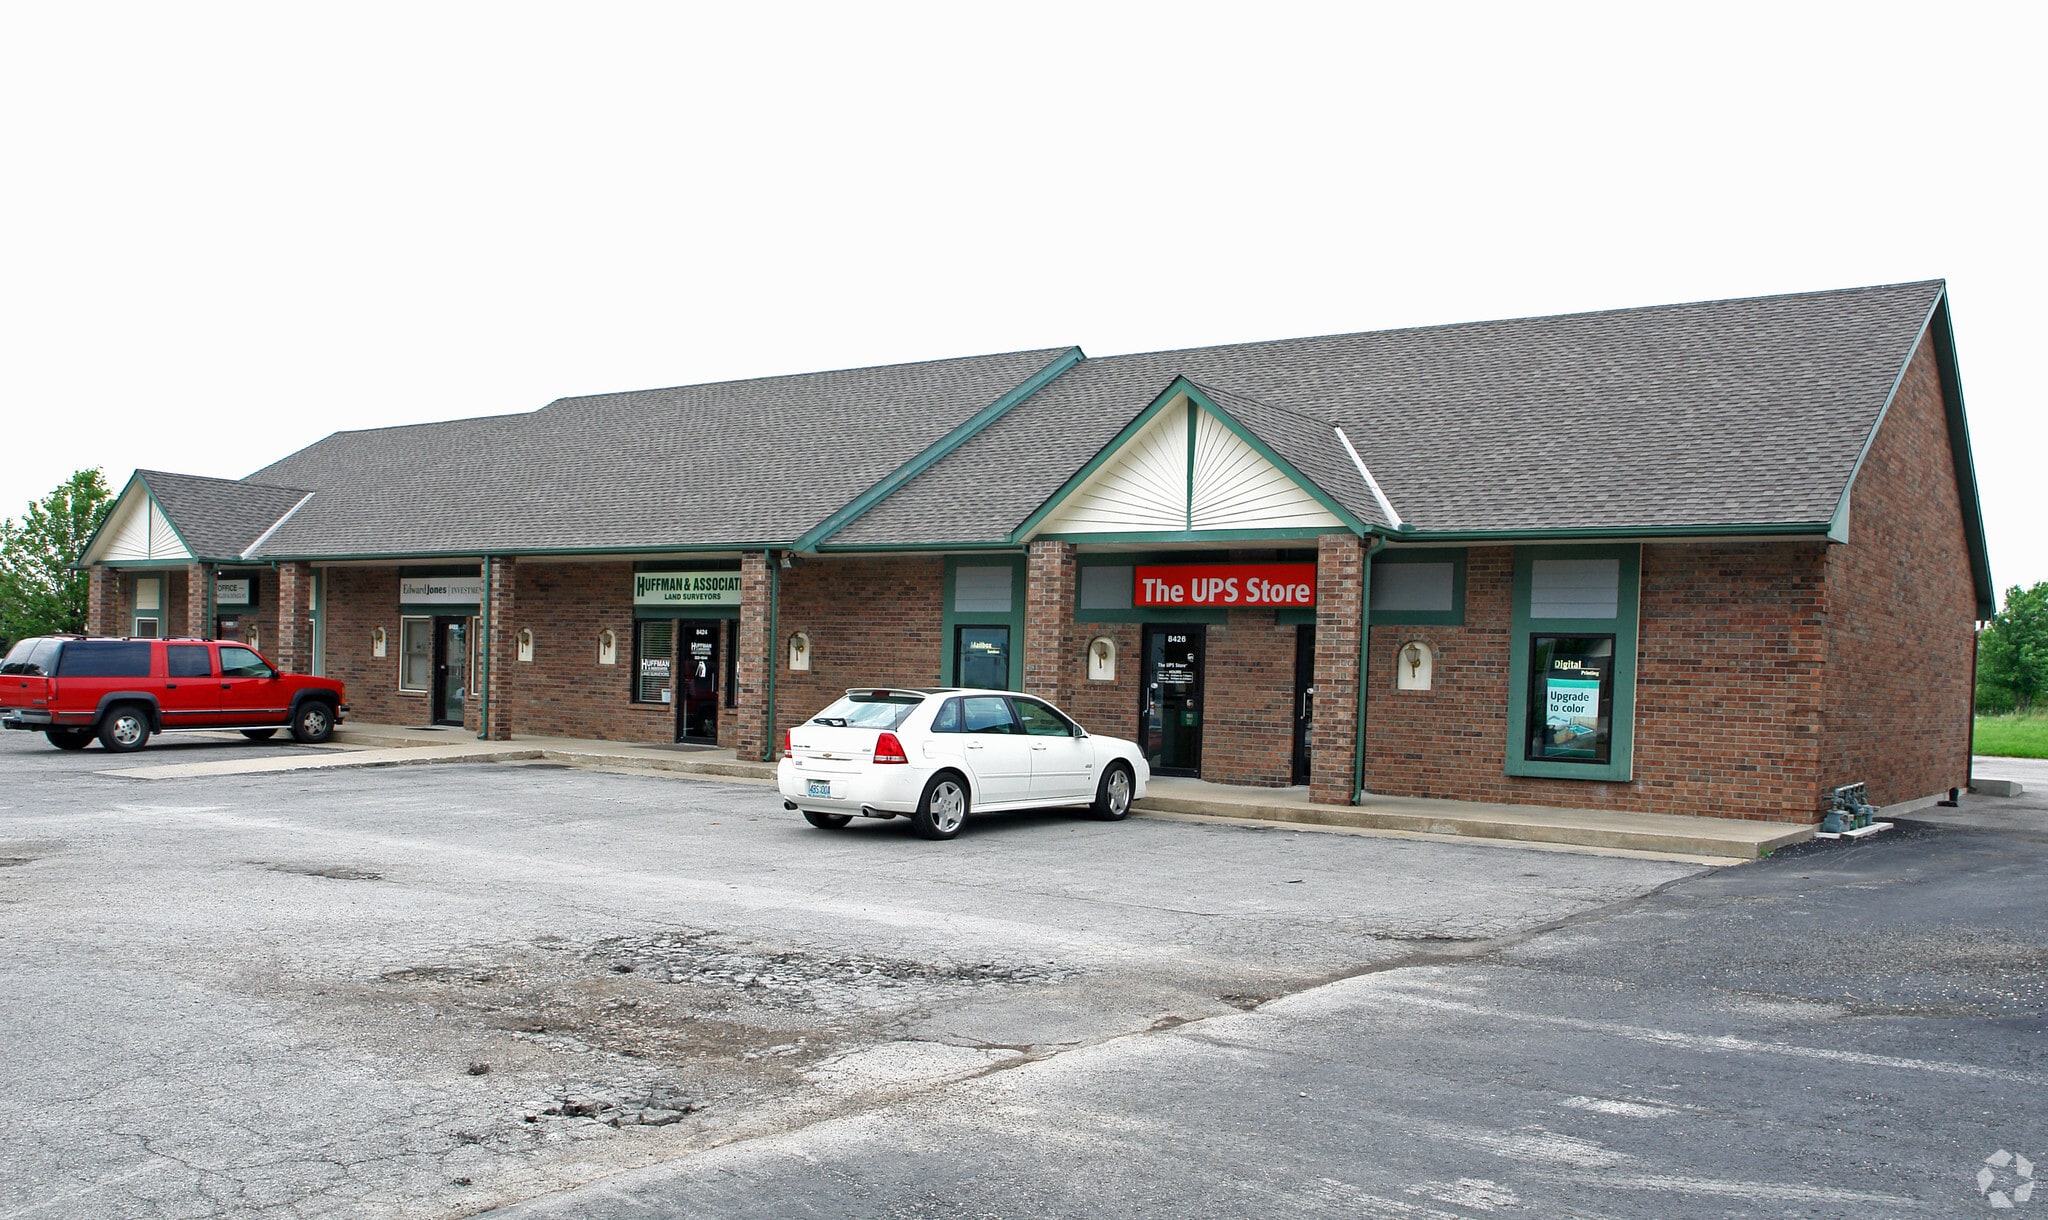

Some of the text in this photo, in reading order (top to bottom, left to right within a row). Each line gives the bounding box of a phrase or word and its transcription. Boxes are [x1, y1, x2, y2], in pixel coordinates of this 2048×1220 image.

[637, 576, 683, 597] HUFFMAN
[684, 577, 691, 591] &
[1142, 577, 1311, 603] The UPS Store
[641, 658, 670, 671] HUFFMAN
[1554, 660, 1581, 670] Digital
[1550, 690, 1590, 703] Upgrade
[1550, 703, 1585, 713] to color
